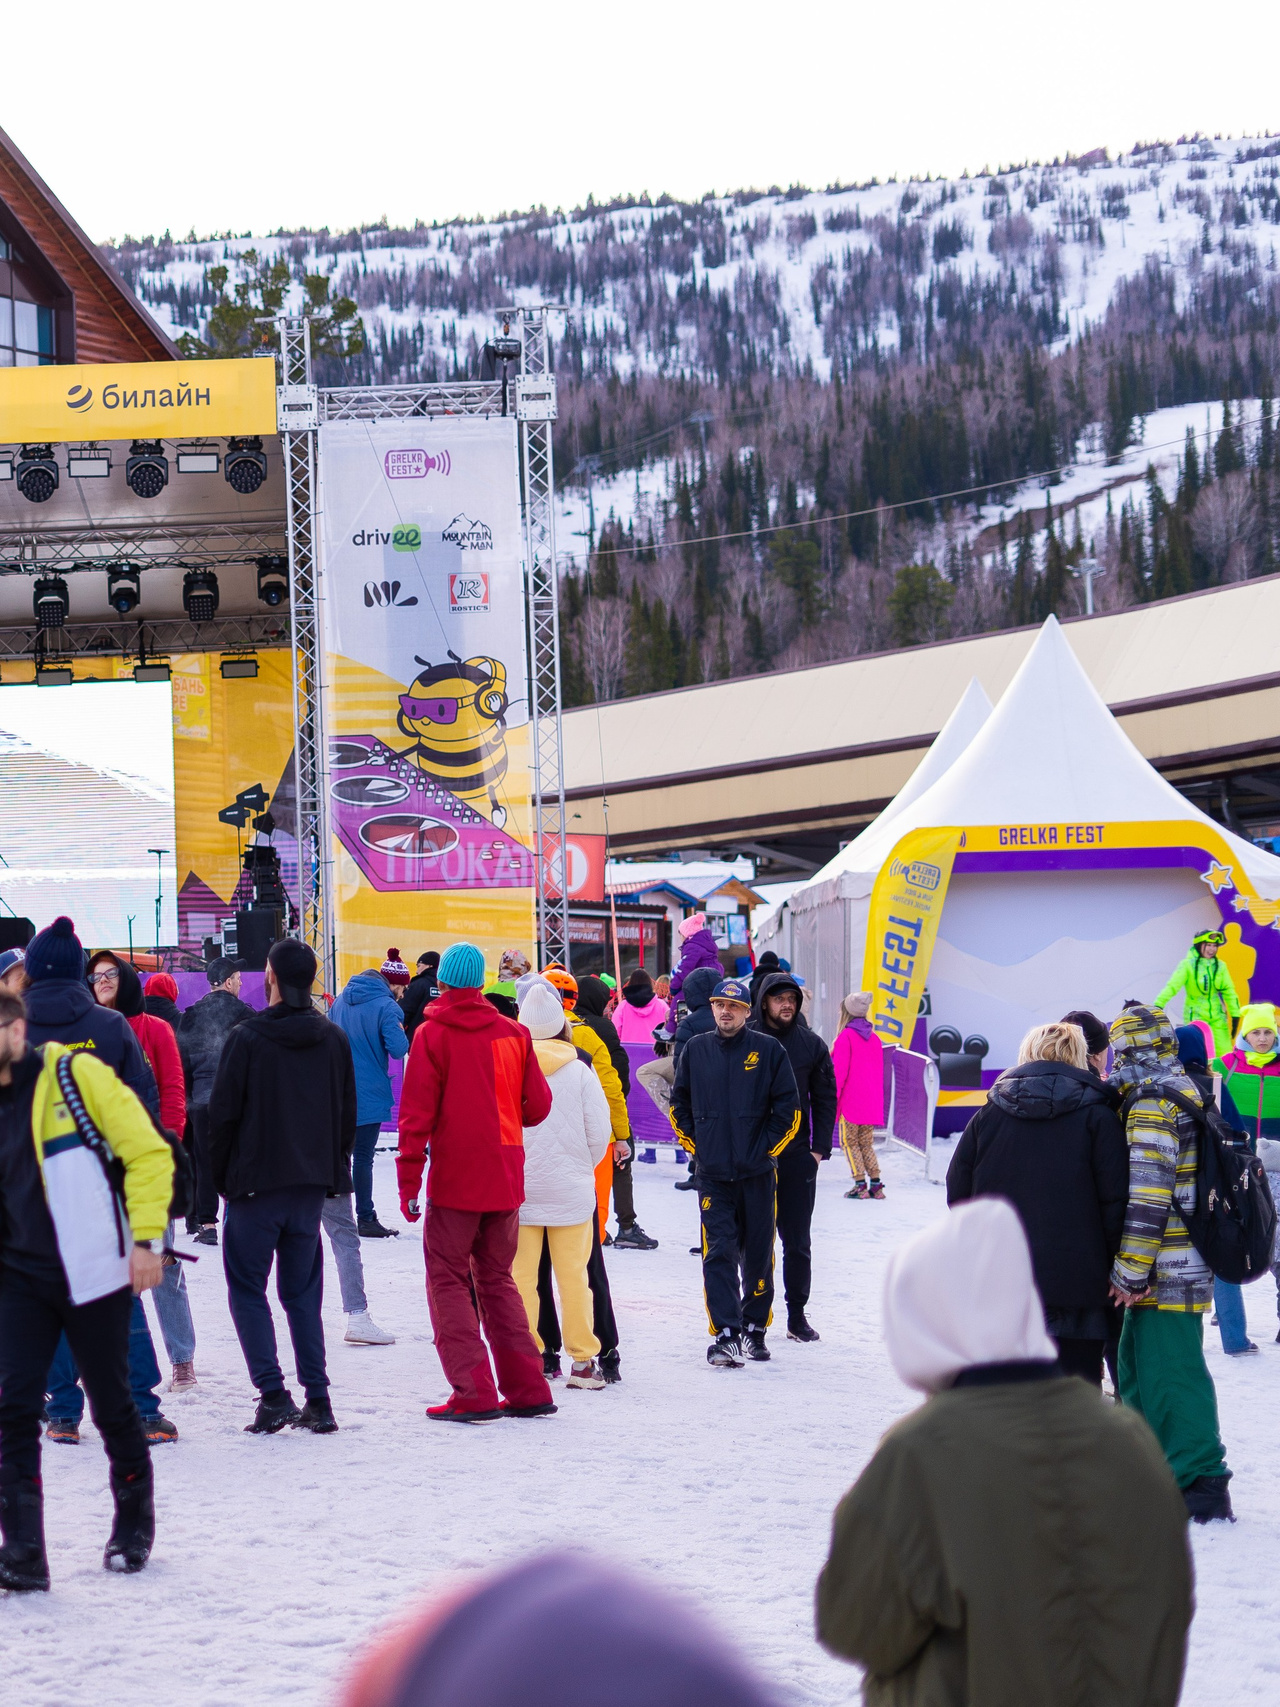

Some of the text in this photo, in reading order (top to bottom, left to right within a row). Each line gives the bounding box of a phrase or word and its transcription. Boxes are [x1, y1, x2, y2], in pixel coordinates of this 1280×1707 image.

[102, 382, 211, 410] билайн
[390, 453, 423, 463] GRELKA
[391, 465, 412, 475] FEST
[352, 528, 421, 546] drivee
[442, 532, 492, 542] MOUNTAIN
[470, 541, 493, 550] MAN
[999, 825, 1105, 845] GRELKA FEST
